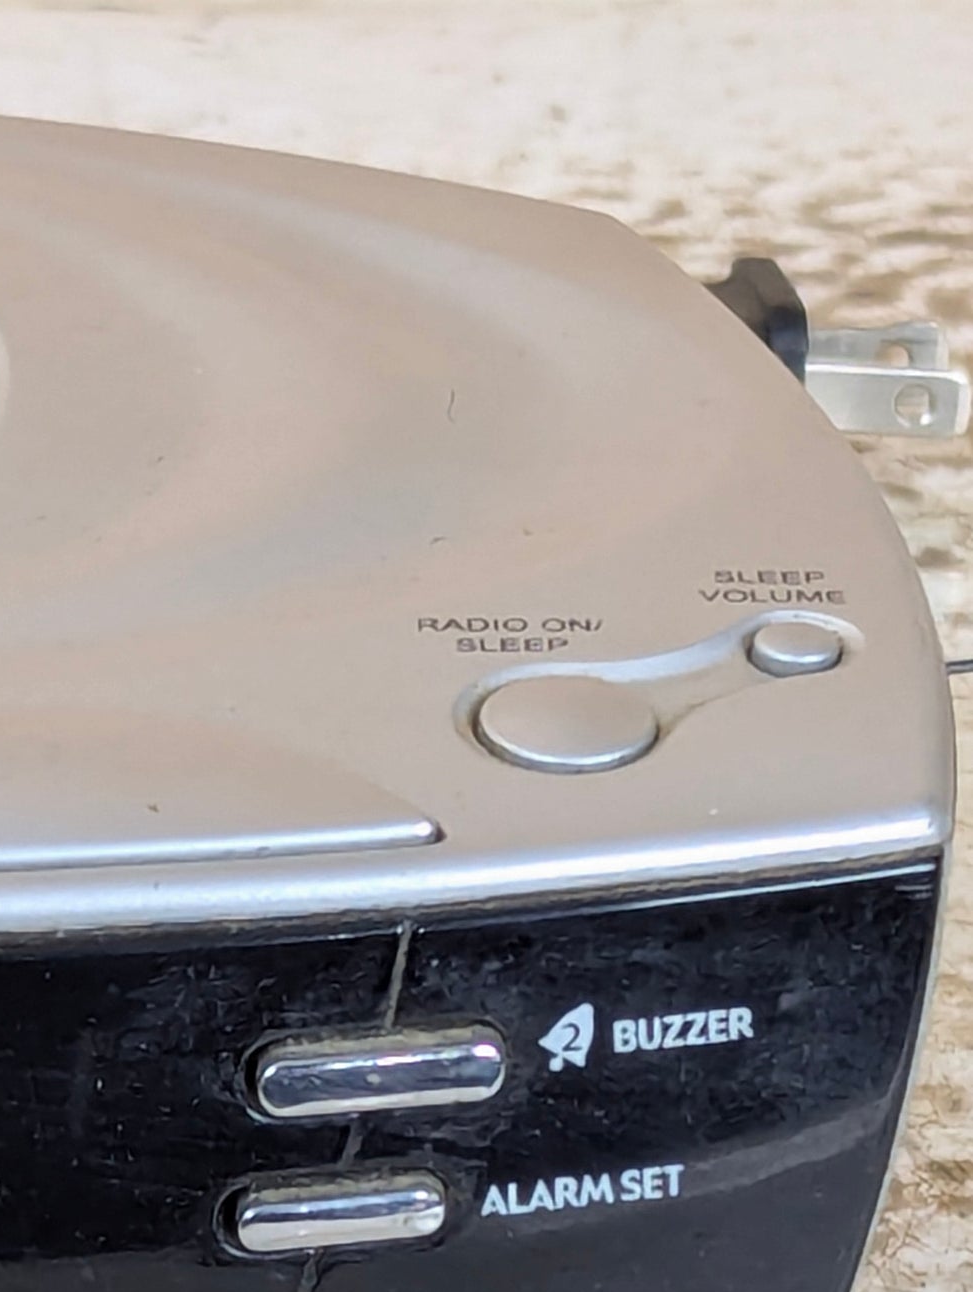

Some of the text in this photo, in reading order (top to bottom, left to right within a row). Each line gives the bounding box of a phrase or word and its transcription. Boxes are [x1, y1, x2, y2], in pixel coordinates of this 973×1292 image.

[713, 570, 826, 586] SLEEP
[698, 588, 847, 604] VOLUME
[417, 616, 604, 633] RADIO ON/
[455, 637, 569, 653] SLEEP
[612, 1006, 754, 1054] BUZZER
[480, 1164, 685, 1217] ALARM SET
